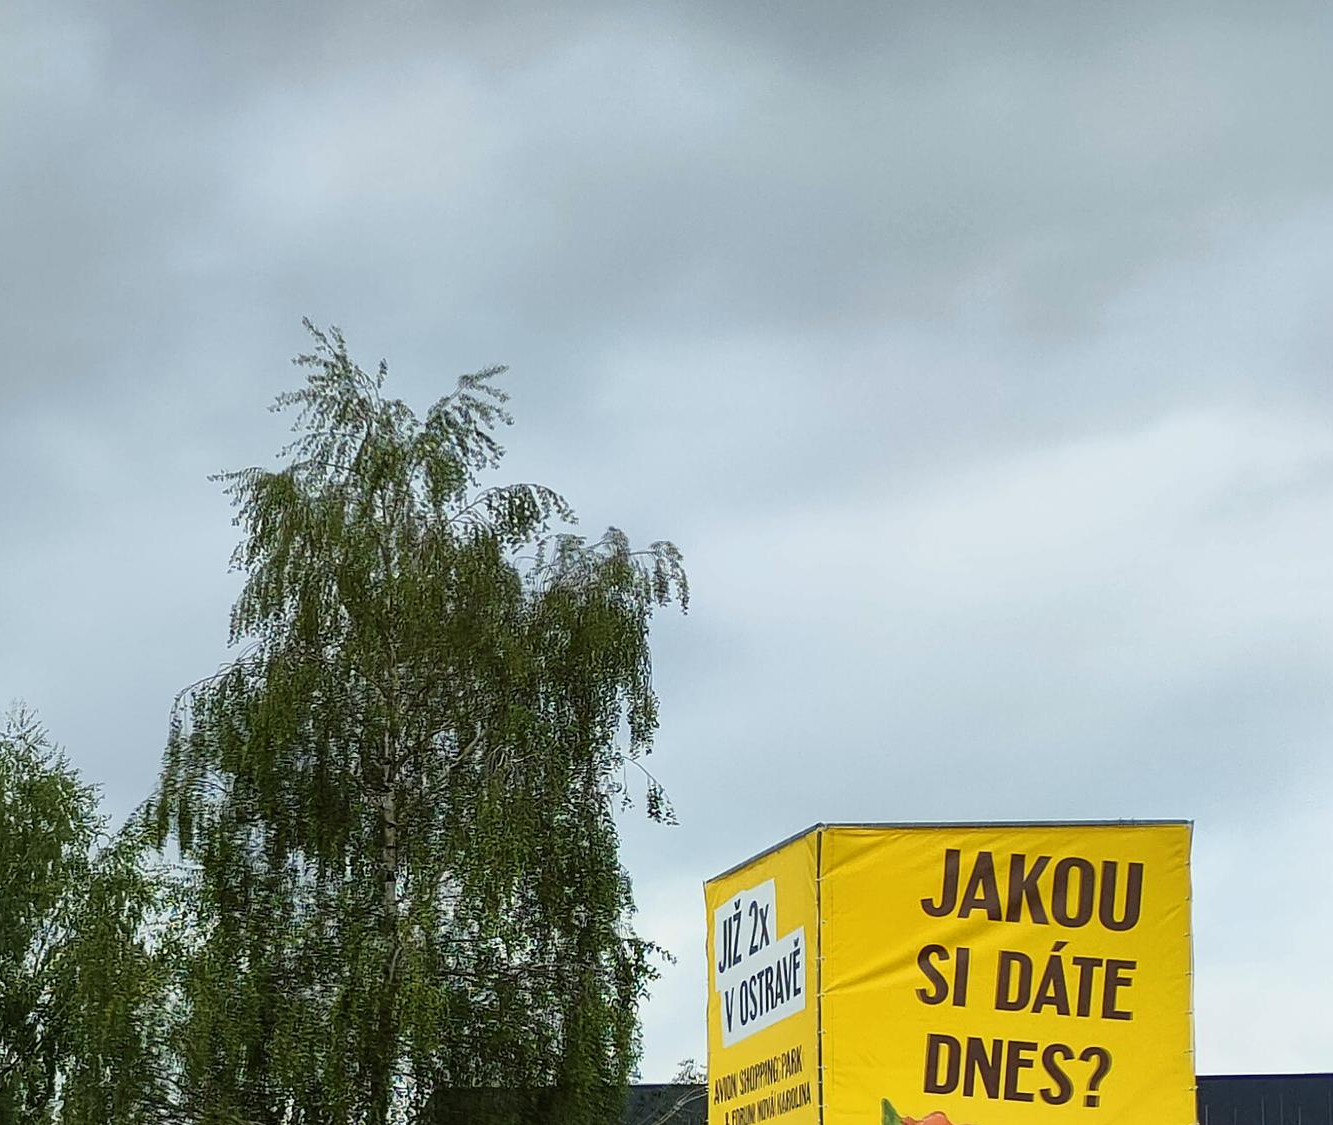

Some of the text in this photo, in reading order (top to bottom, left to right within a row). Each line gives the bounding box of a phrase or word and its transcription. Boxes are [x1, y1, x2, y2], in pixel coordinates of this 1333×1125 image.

[920, 848, 1144, 932] JAKOU
[719, 898, 743, 974] JIŽ
[724, 938, 802, 1033] V OSTRAVĚ
[915, 940, 1137, 1021] SI DÁTE
[713, 1045, 804, 1105] AVION SHOPPING PARK
[923, 1033, 1112, 1108] DNES?
